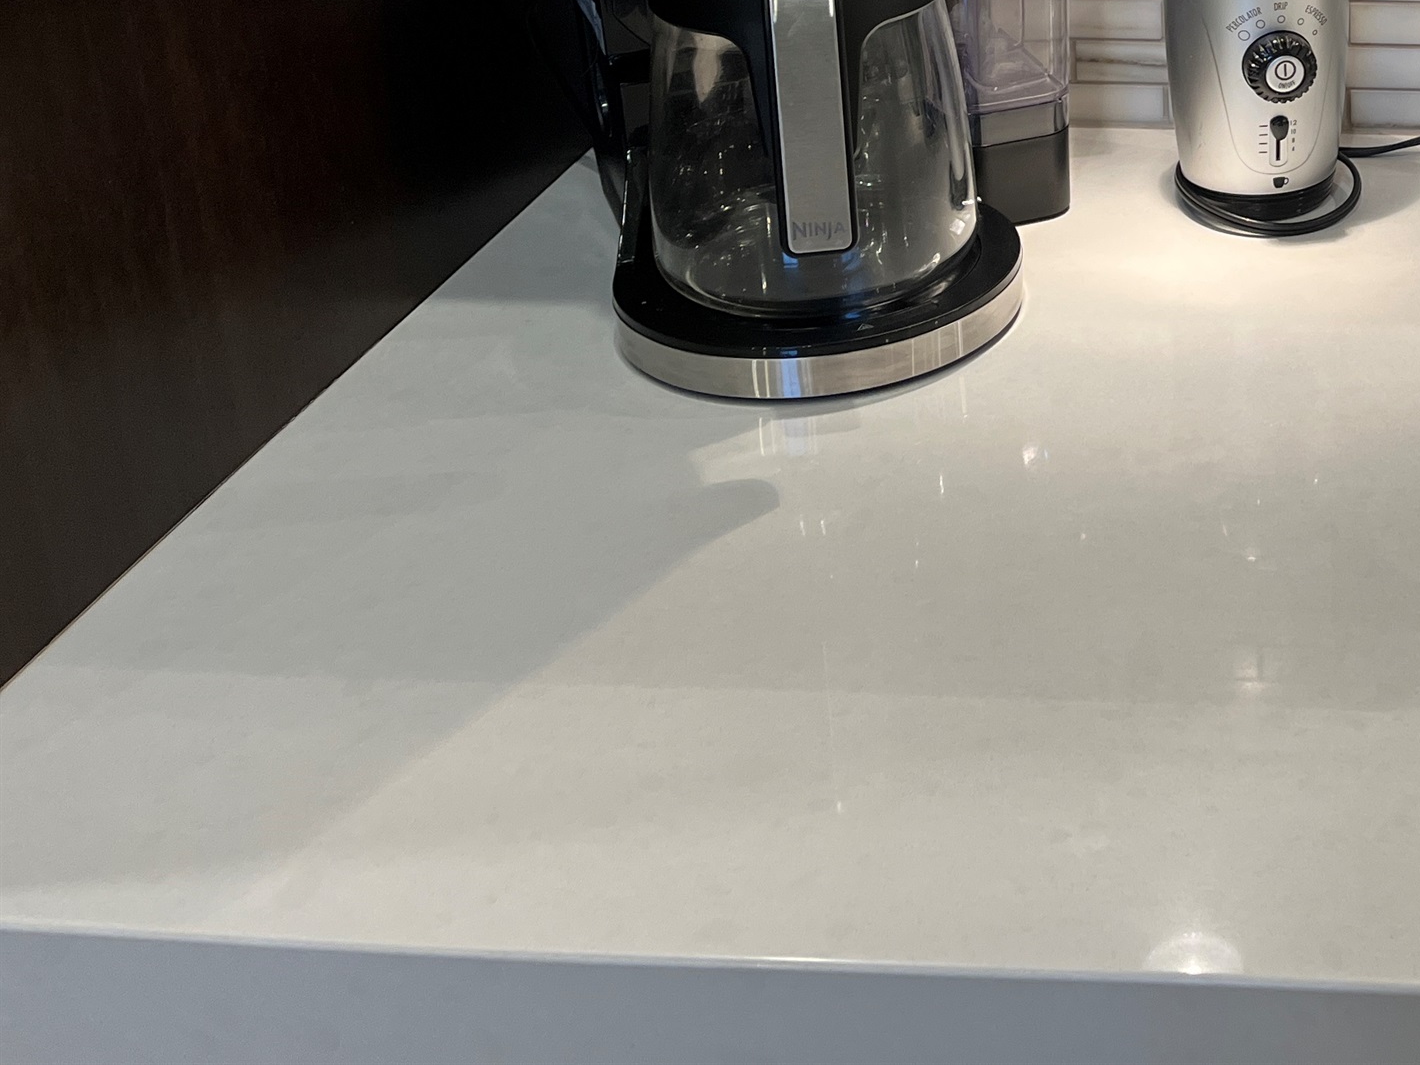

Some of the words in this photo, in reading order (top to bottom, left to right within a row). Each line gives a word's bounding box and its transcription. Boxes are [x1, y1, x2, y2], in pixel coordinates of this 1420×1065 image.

[1226, 6, 1262, 33] PERCOLATOR
[1274, 2, 1288, 11] DRIP
[1305, 5, 1328, 26] ESPRESSO
[792, 221, 846, 241] NINJA
